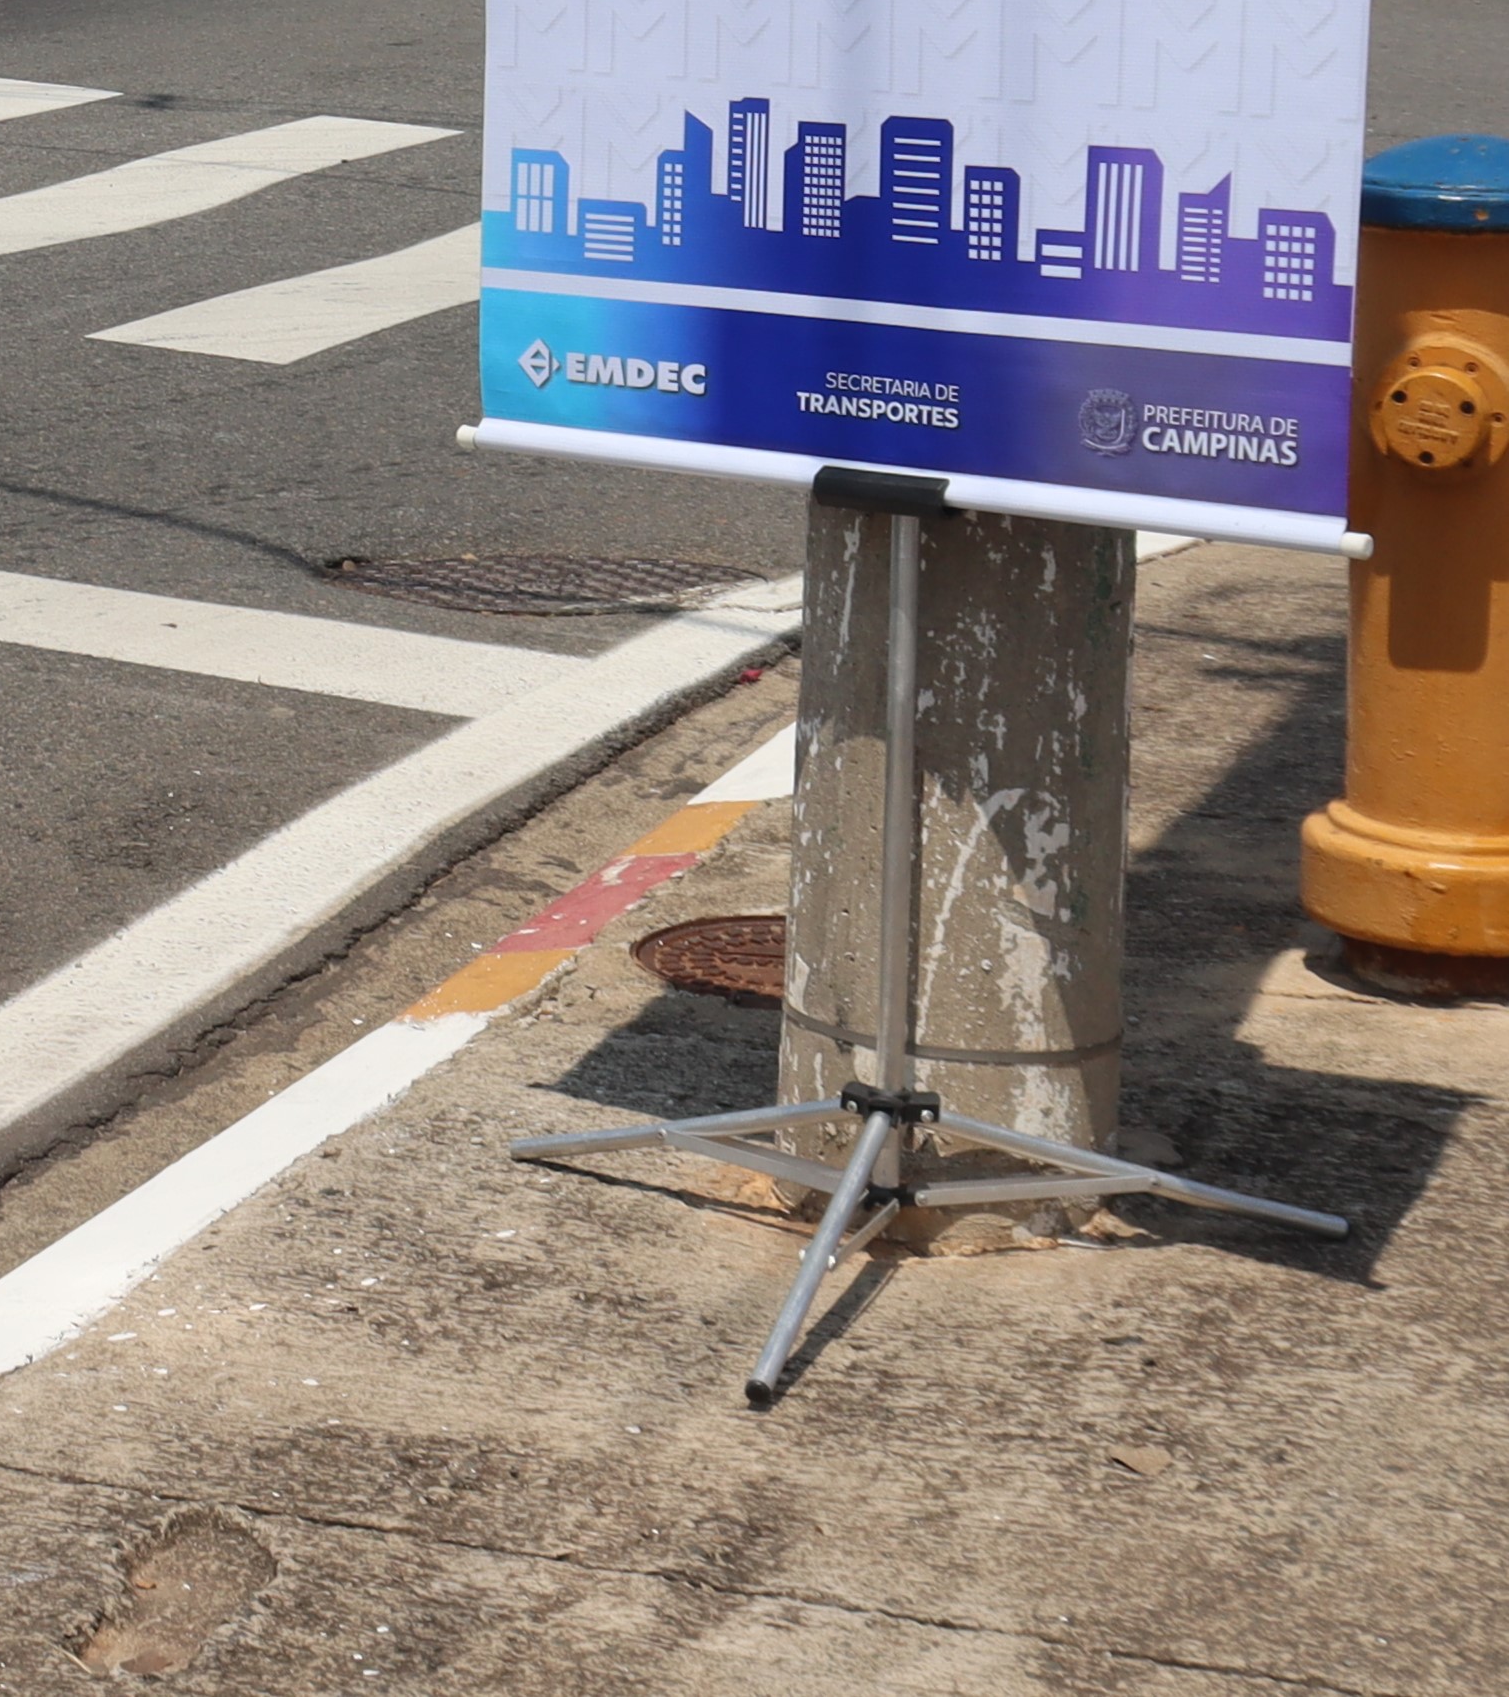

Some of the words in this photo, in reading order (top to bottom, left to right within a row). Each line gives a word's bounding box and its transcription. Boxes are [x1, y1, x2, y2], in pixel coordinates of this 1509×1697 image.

[567, 353, 705, 393] EMDEC
[825, 372, 931, 399] SECRETARIA
[935, 383, 960, 403] DE
[796, 391, 959, 428] TRANSPORTES
[1143, 404, 1264, 434] PREFEITURA
[1270, 417, 1299, 437] DE
[1142, 426, 1297, 466] CAMPINAS
